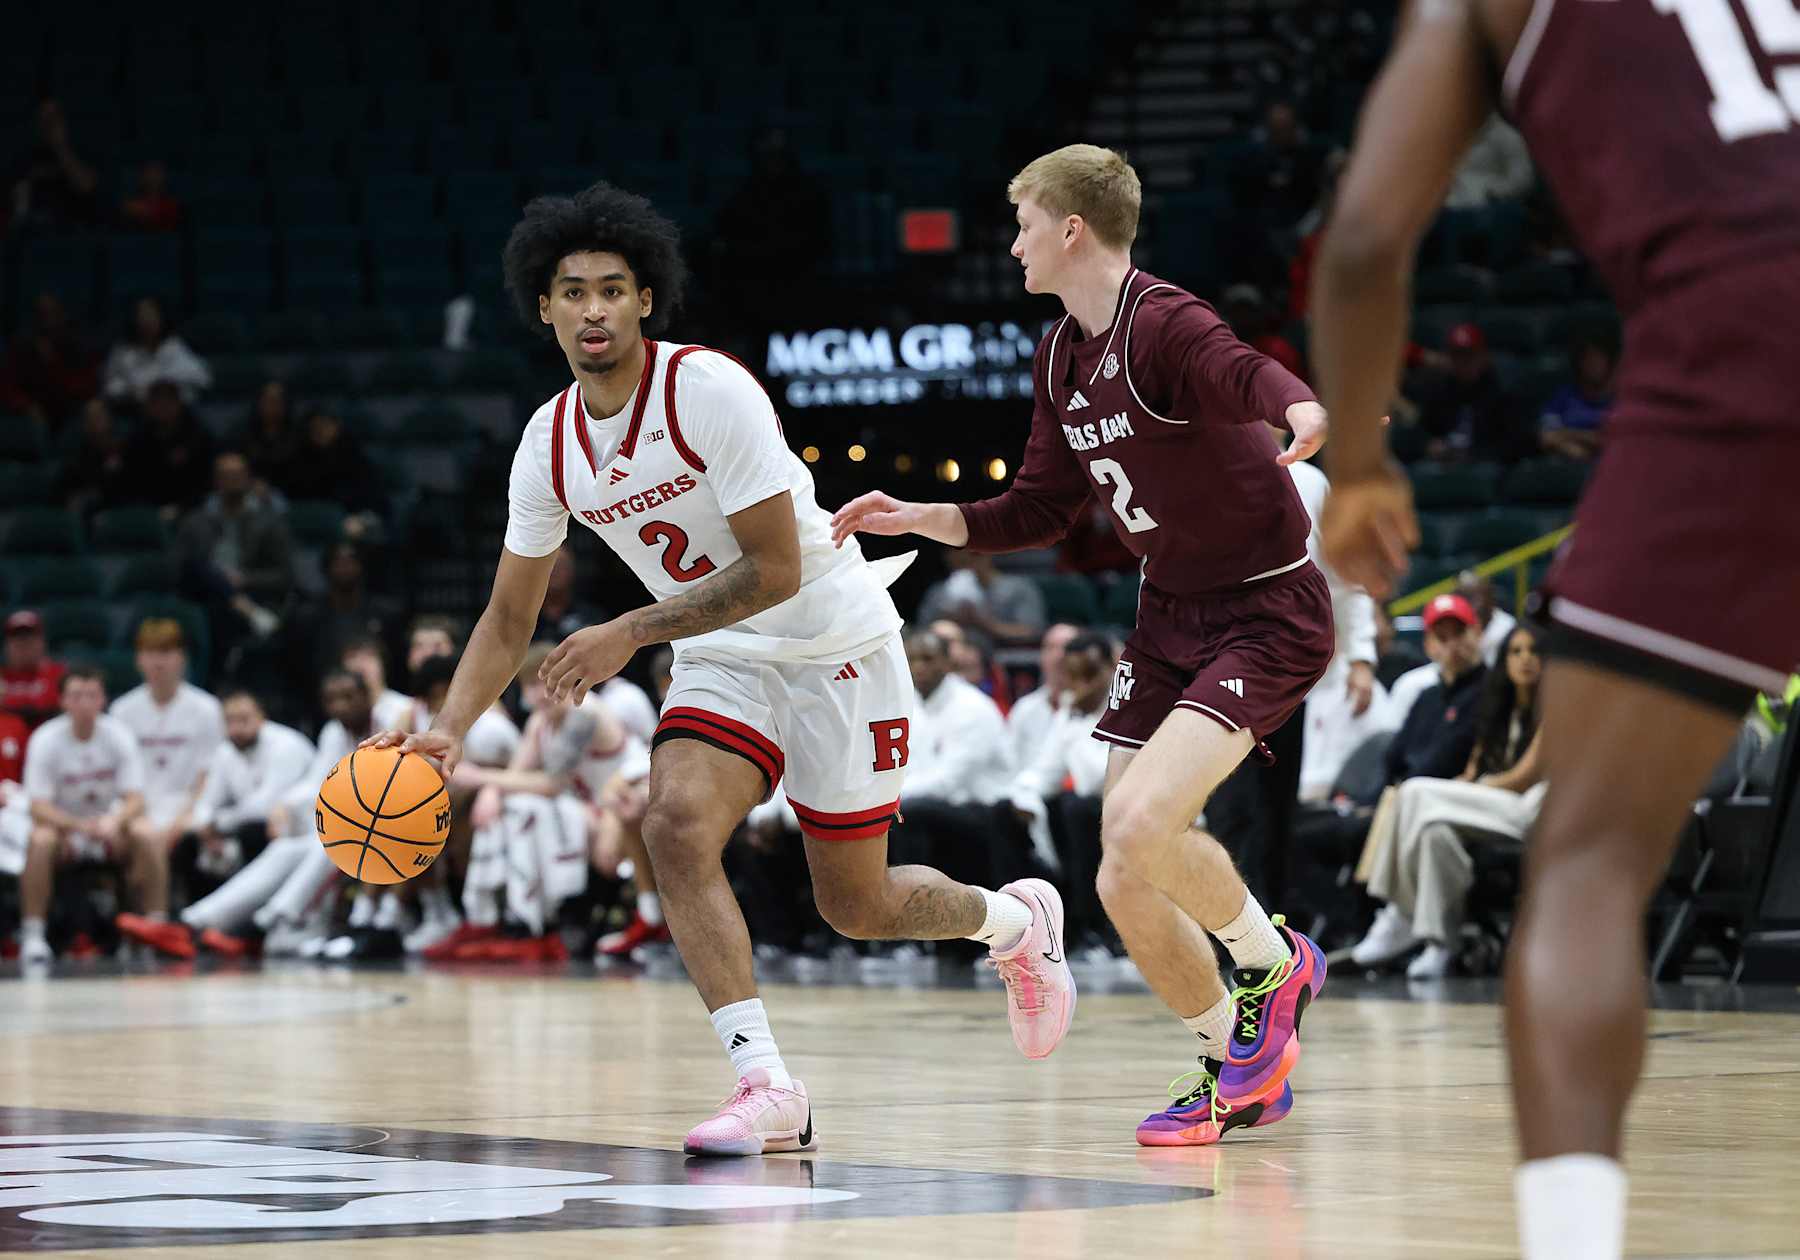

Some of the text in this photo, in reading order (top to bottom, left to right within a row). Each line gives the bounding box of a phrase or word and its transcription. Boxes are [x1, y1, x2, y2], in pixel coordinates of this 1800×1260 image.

[766, 328, 894, 376] MGM
[1100, 412, 1135, 444] A&M
[580, 473, 697, 525] RUTGERS
[1089, 457, 1160, 533] 2
[638, 520, 718, 583] 2
[868, 717, 910, 773] R
